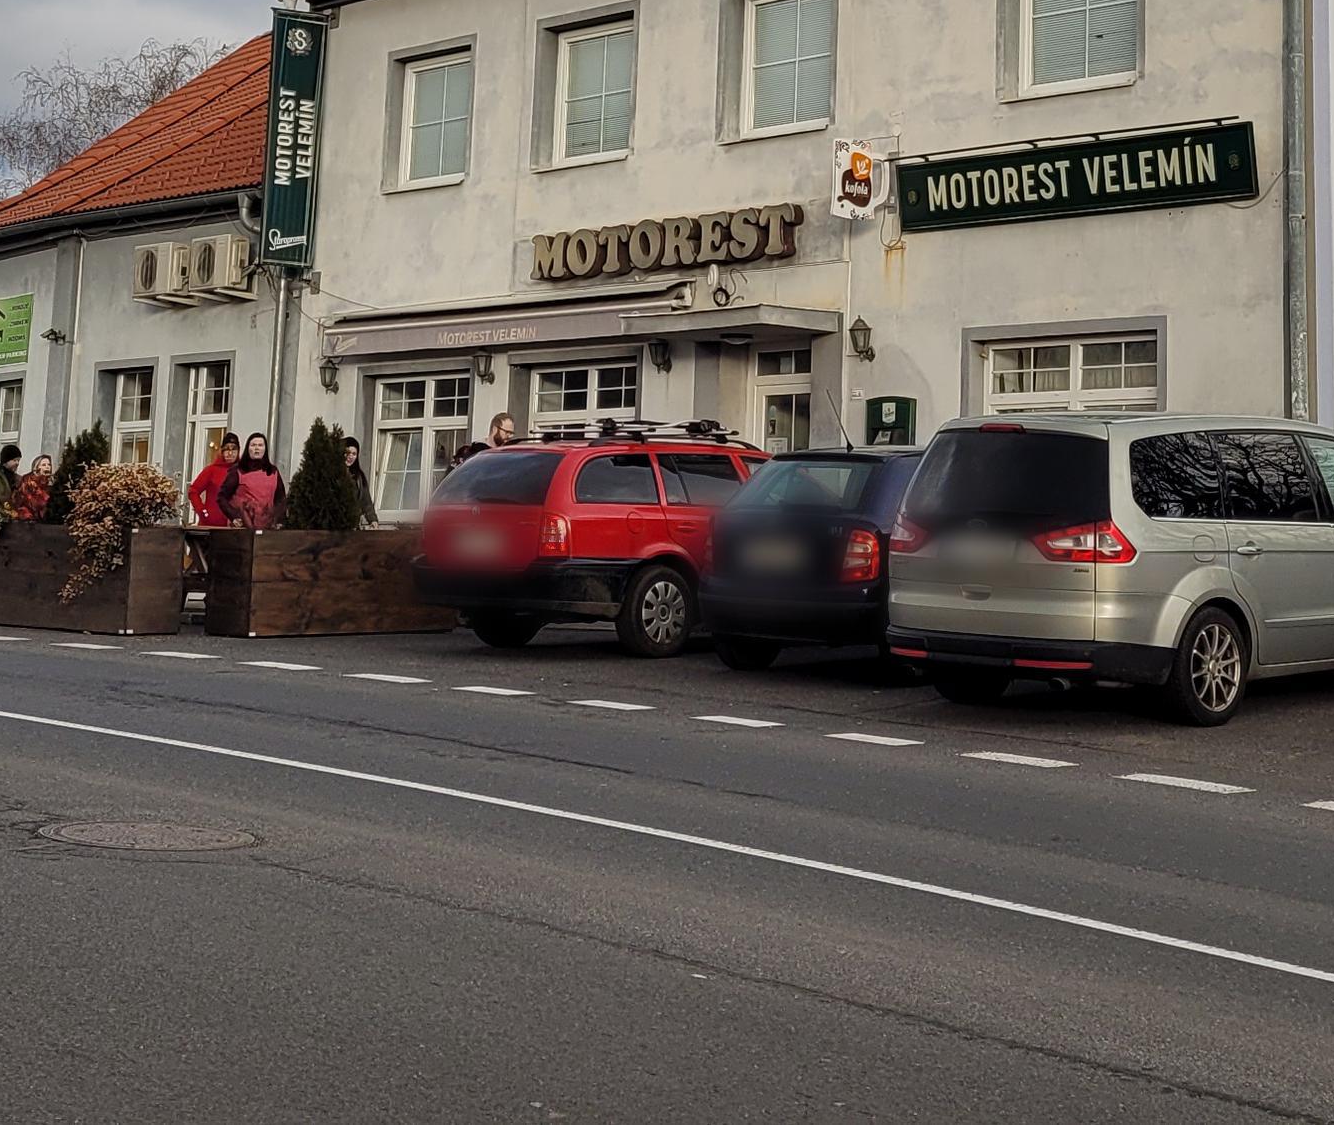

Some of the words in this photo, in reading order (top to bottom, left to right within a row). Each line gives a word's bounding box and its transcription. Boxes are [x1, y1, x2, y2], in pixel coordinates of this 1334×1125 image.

[273, 86, 297, 186] MOTOREST
[294, 98, 316, 180] VELEMÍN
[926, 160, 1070, 213] MOTOREST
[1081, 136, 1217, 196] VELEMÍN
[530, 202, 804, 280] MOTOREST
[436, 329, 492, 346] MOTOREST
[492, 323, 537, 341] VELEMÍN
